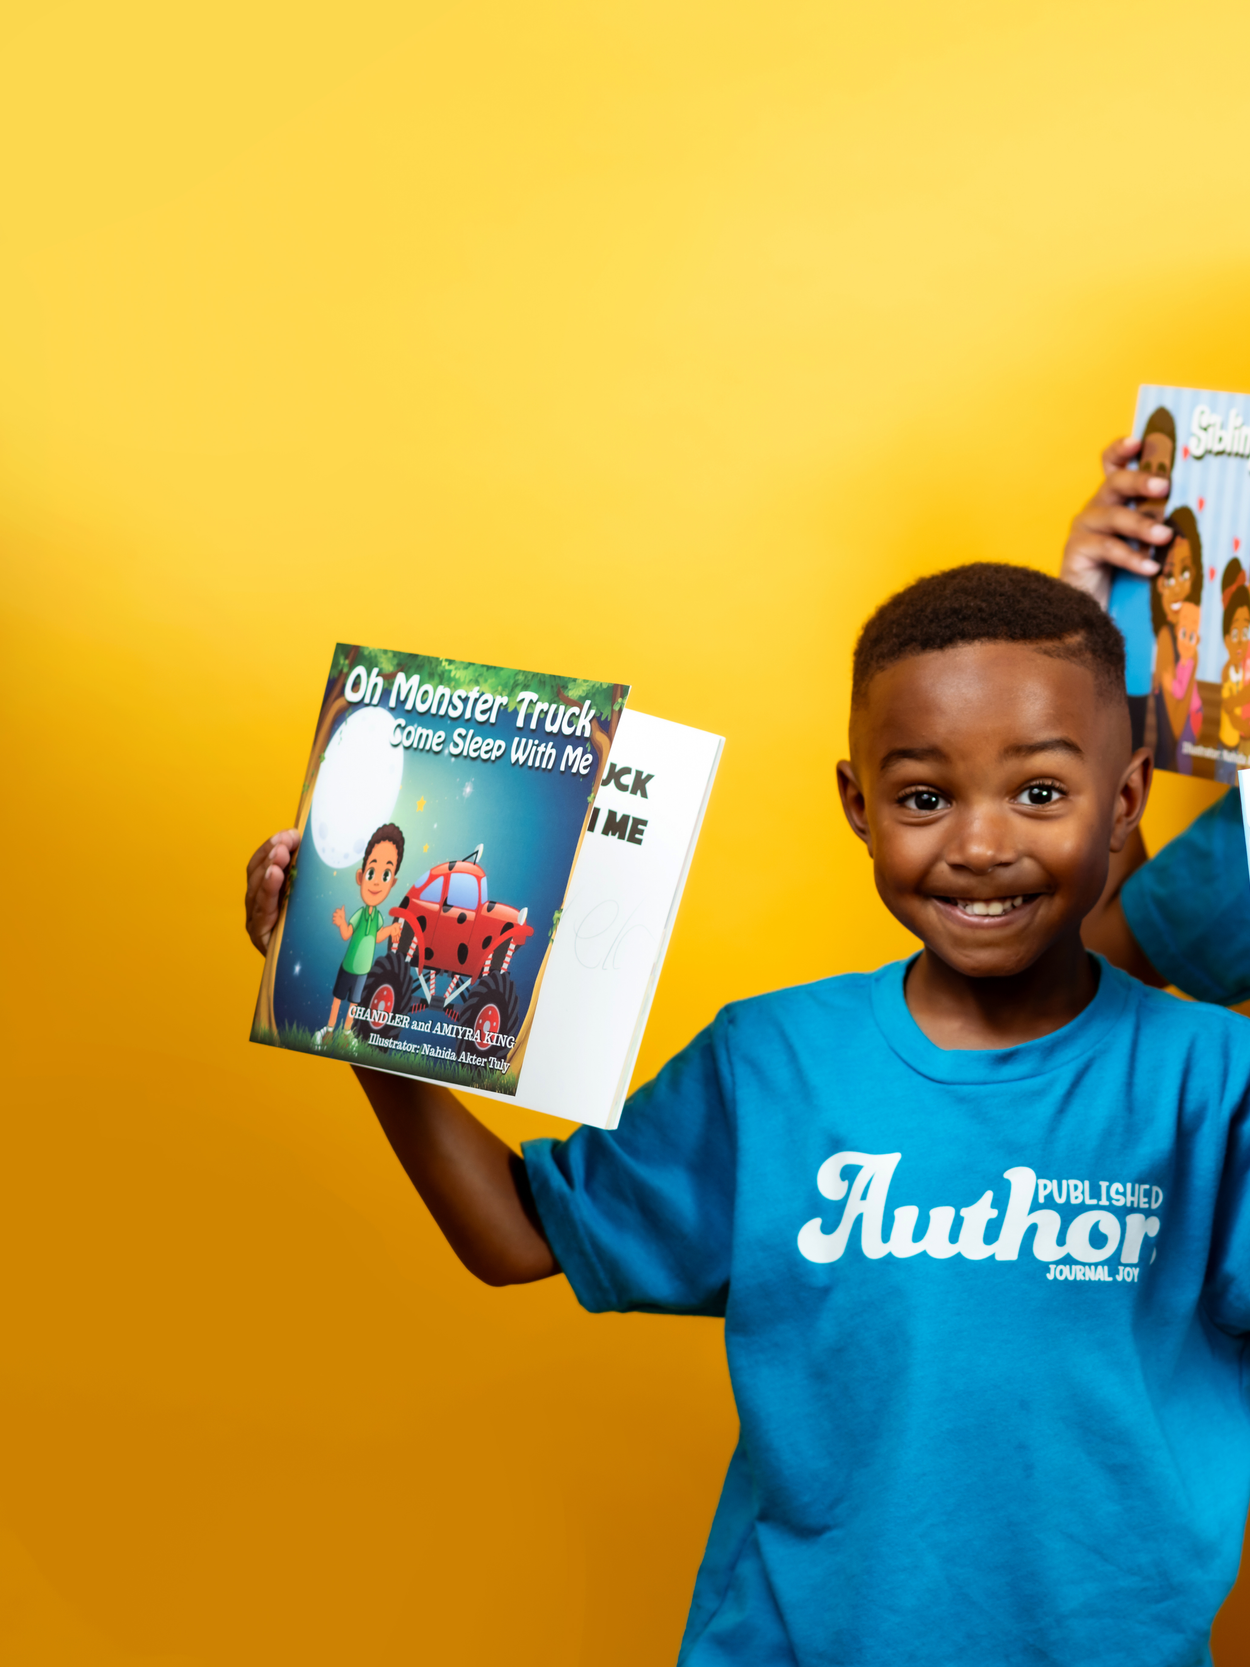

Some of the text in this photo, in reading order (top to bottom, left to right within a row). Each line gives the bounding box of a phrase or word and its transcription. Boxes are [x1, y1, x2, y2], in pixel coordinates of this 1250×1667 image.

[344, 665, 596, 738] Oh Monster Truck
[389, 718, 593, 775] Come Sleep With Me
[601, 809, 649, 846] ME
[348, 1005, 516, 1049] CHANDLER and AMIYRA KING
[368, 1033, 510, 1074] Illustrator: Nahida Akter Tuly
[797, 1150, 1160, 1264] Author
[1037, 1178, 1163, 1209] PUBLISHED
[1046, 1264, 1139, 1282] JOURNAL JOY
